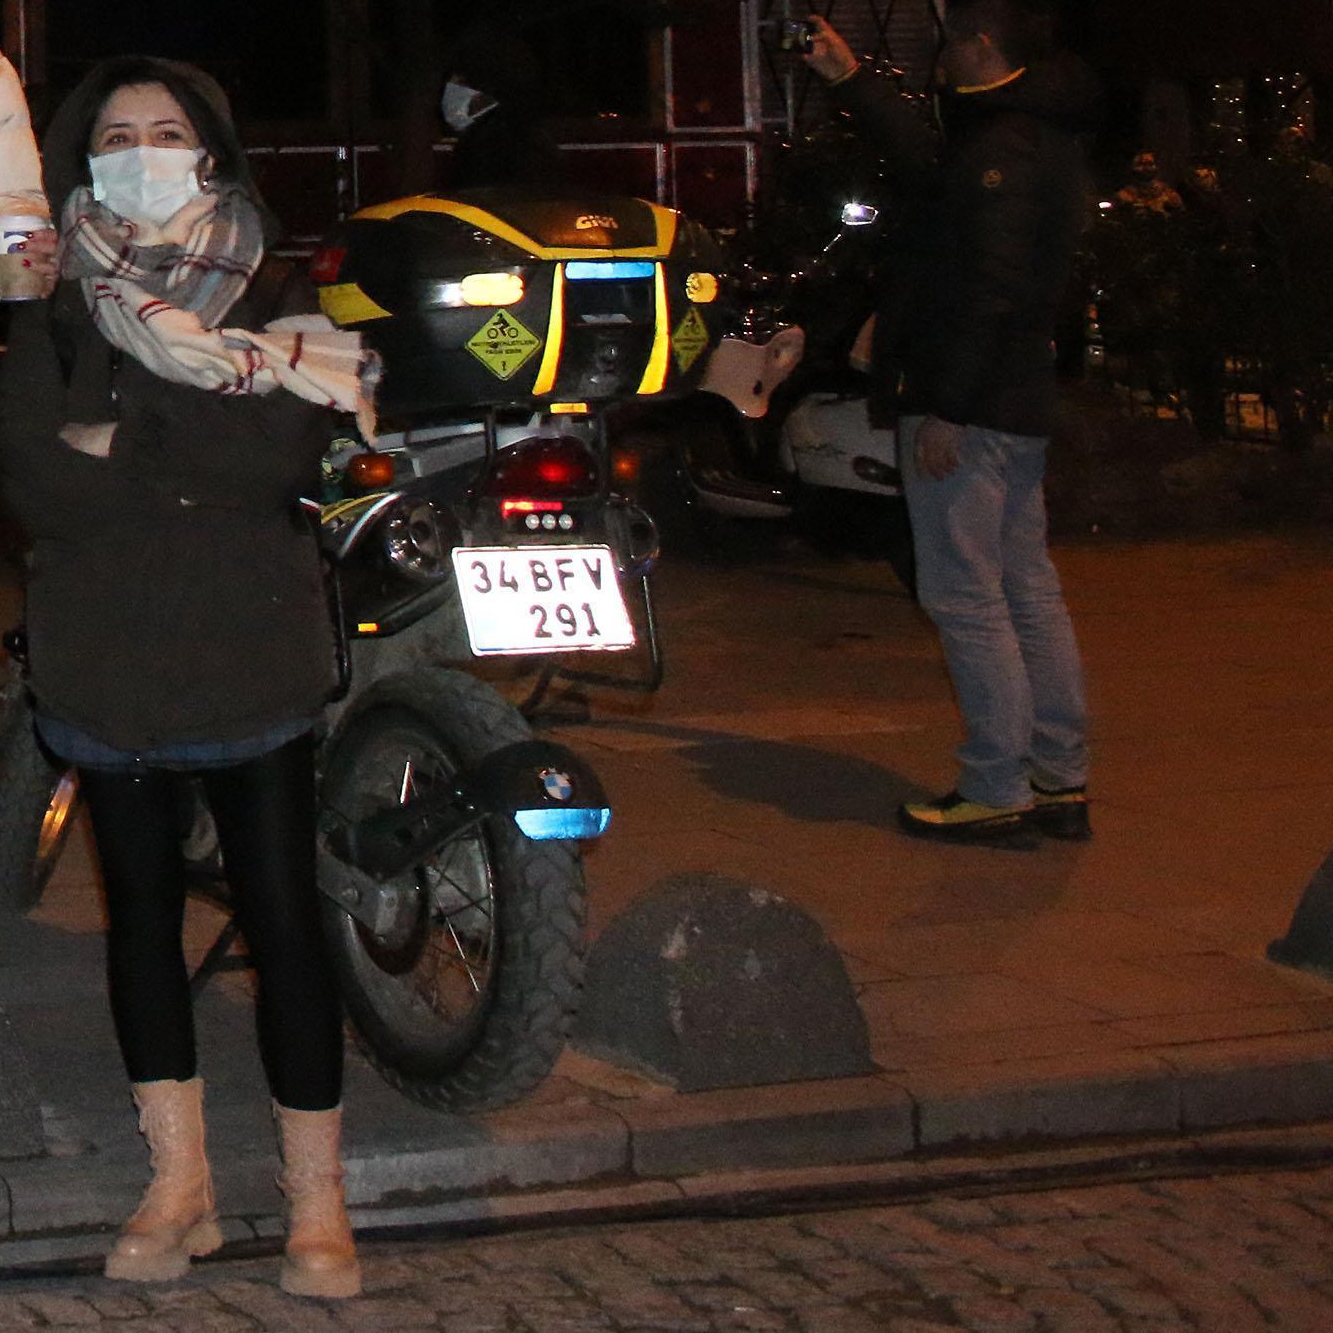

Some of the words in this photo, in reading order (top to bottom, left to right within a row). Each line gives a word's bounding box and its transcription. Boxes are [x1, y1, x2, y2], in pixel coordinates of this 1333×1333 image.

[470, 560, 518, 593] 34
[529, 558, 601, 592] BFV
[529, 602, 601, 638] 291
